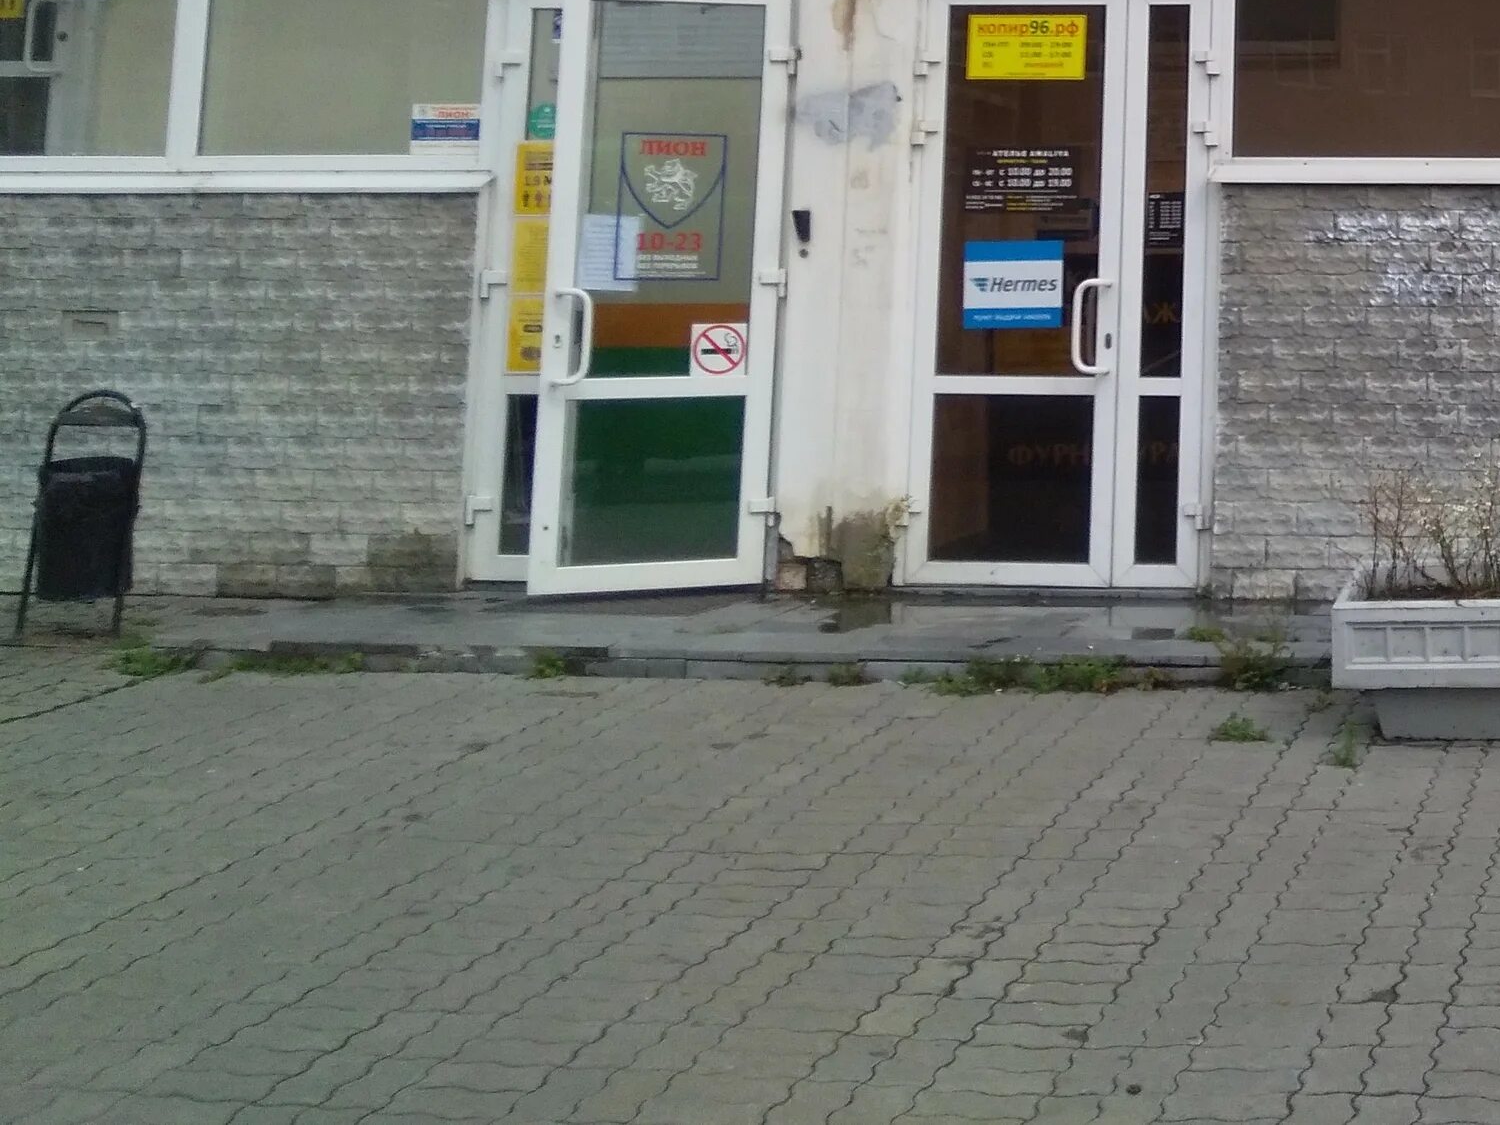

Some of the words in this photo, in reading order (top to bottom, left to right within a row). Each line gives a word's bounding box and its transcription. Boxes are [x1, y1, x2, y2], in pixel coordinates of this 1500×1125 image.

[640, 139, 708, 156] ЛИОН
[637, 232, 703, 251] 10-23
[990, 277, 1058, 292] Hermes
